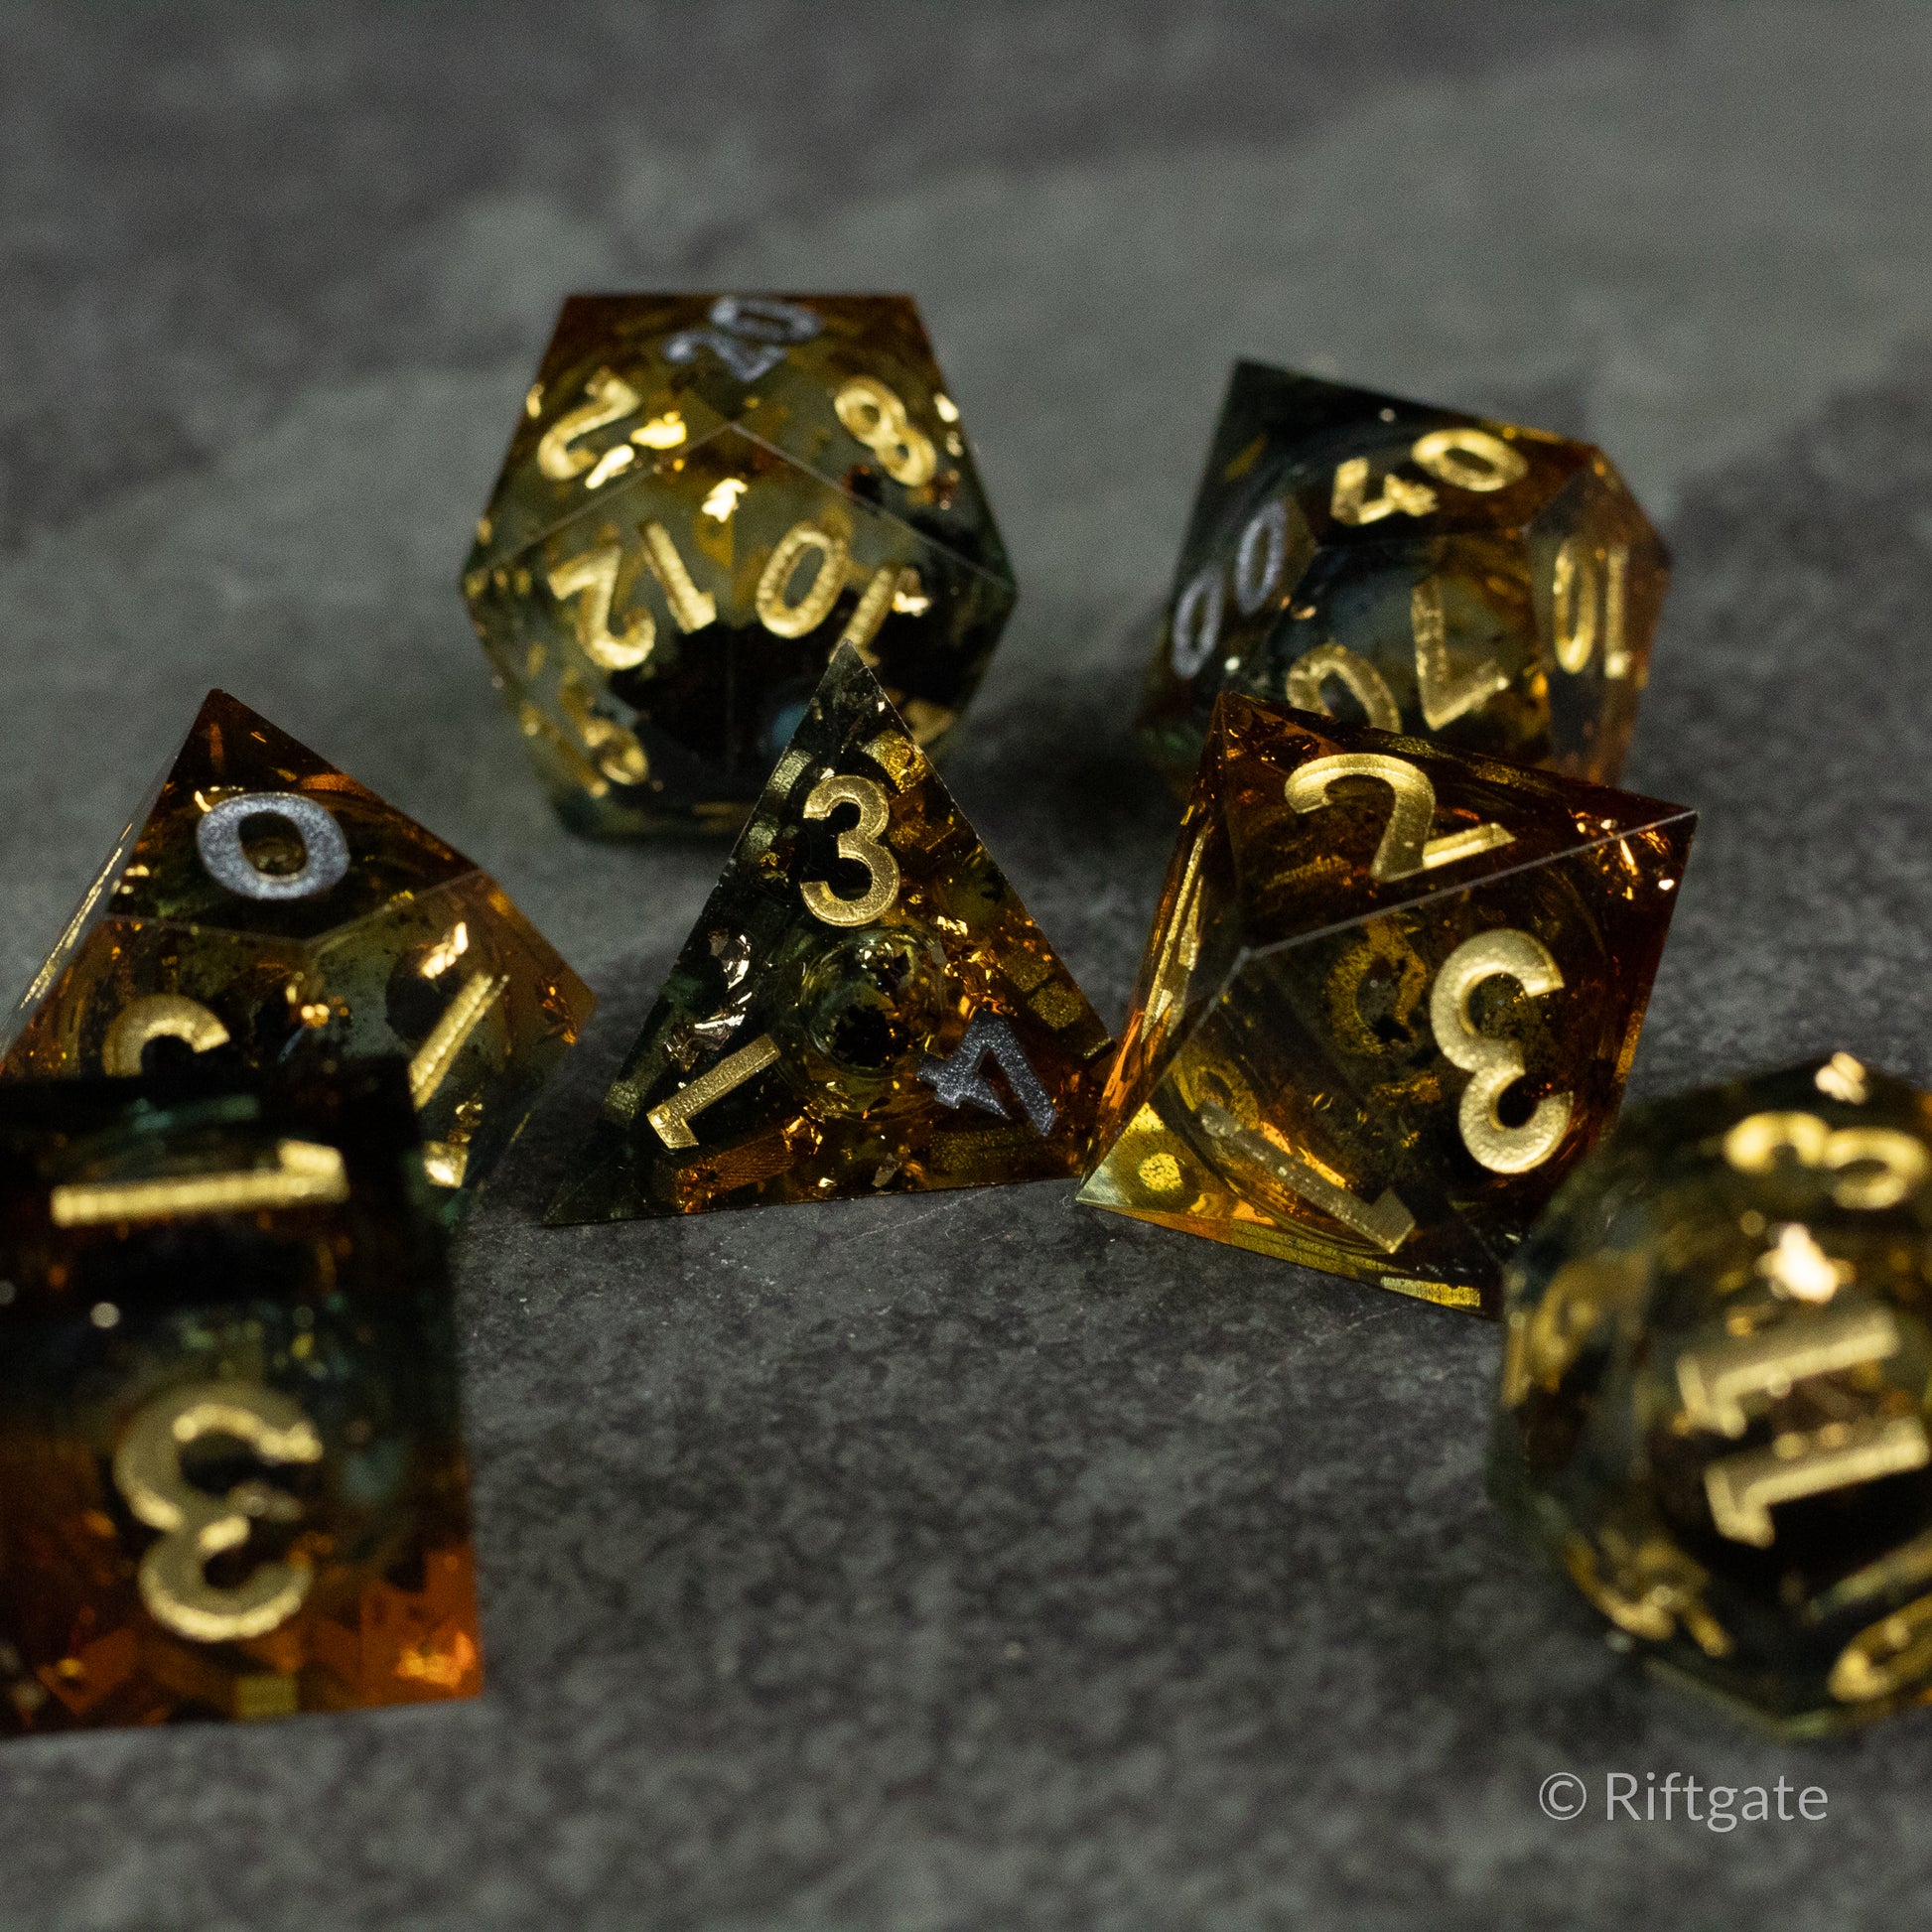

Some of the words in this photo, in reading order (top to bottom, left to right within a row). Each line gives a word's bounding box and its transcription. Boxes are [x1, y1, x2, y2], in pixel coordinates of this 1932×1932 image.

[834, 375, 937, 485] 8
[1328, 427, 1528, 526] 40
[549, 522, 717, 670] 12
[1173, 499, 1289, 679] 00
[197, 791, 350, 899] 0
[800, 774, 900, 927] 3
[1284, 753, 1517, 883] 2
[646, 1033, 781, 1150] 1
[916, 1010, 1057, 1137] 4
[1431, 928, 1575, 1174] 3
[1675, 1309, 1928, 1550] 11
[113, 1387, 324, 1641] 3
